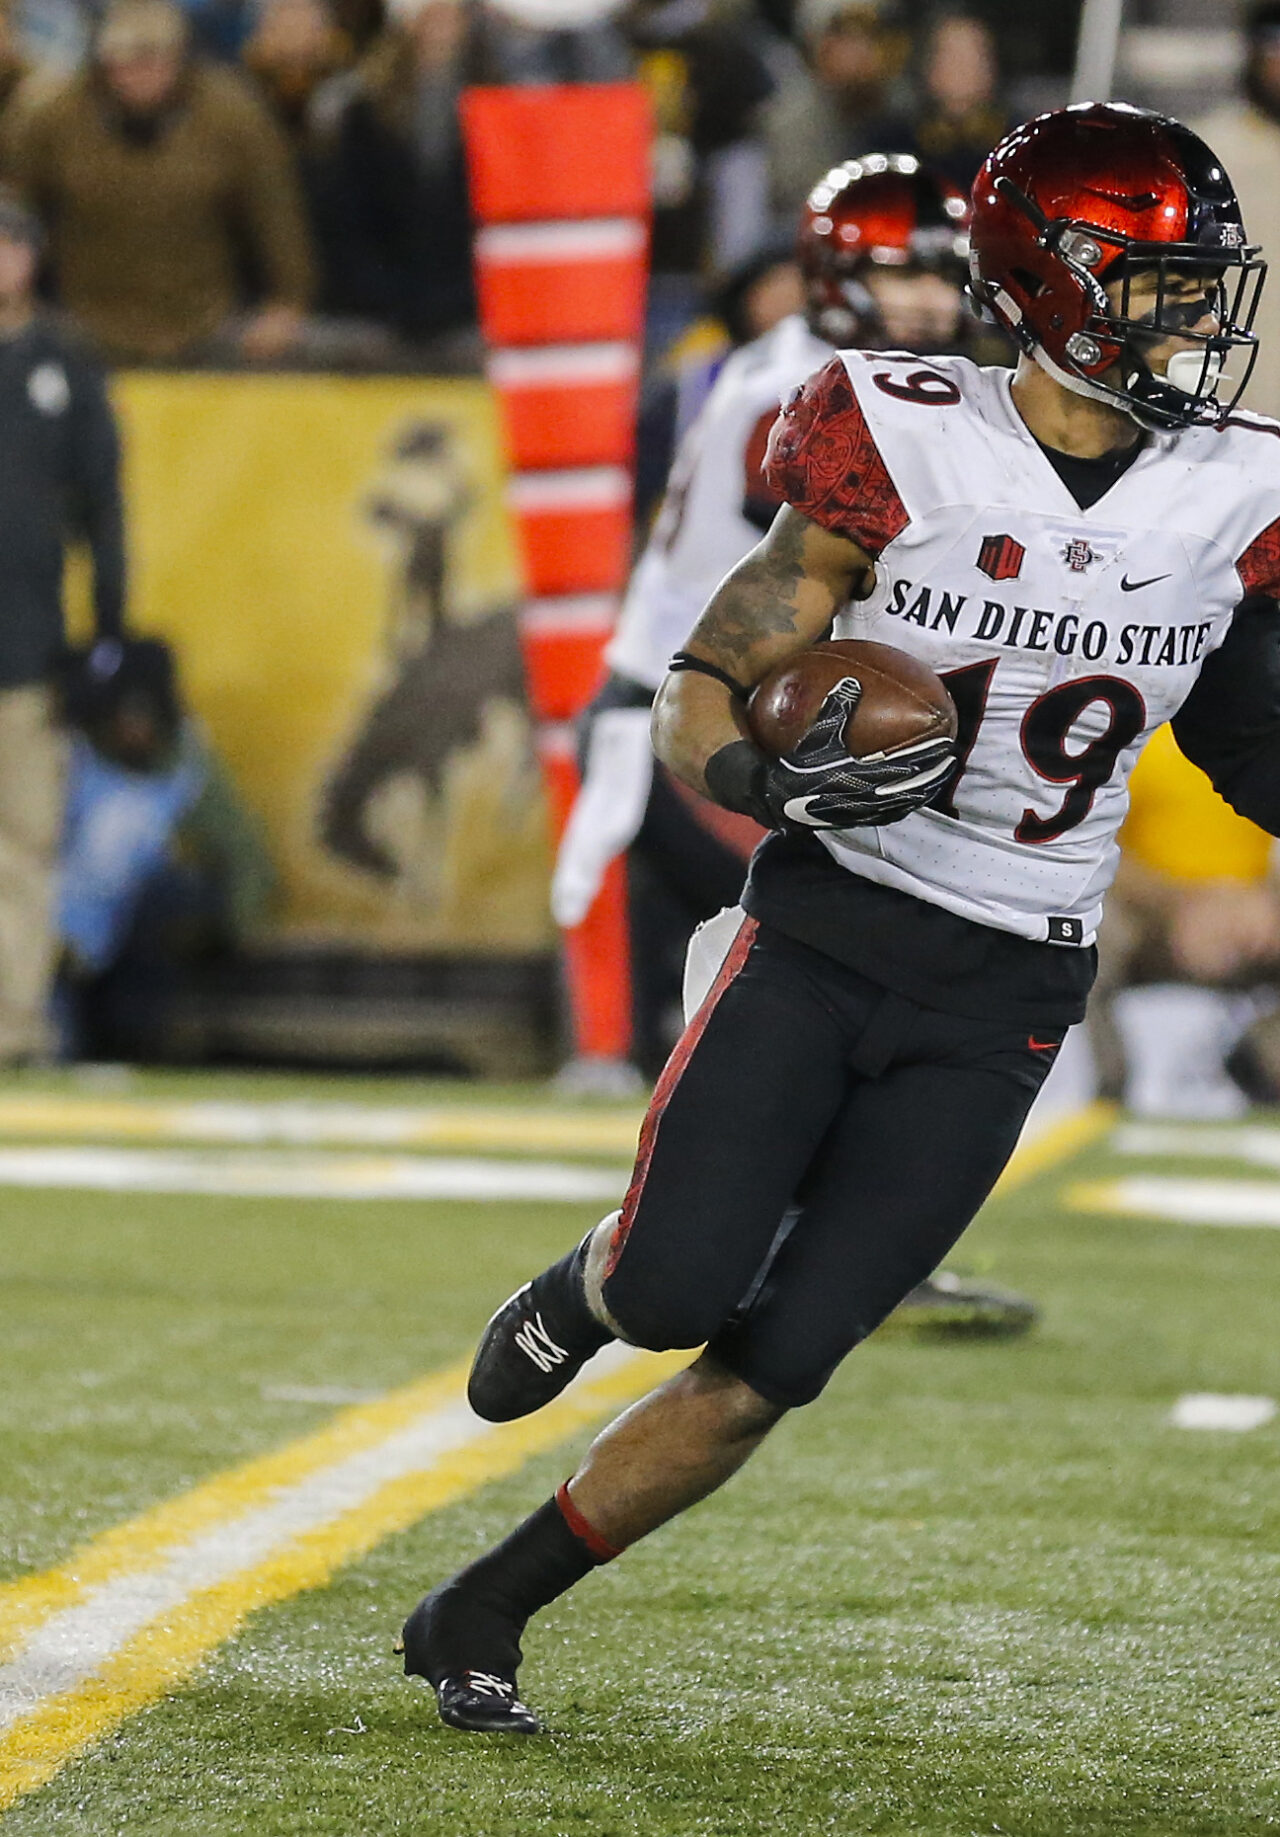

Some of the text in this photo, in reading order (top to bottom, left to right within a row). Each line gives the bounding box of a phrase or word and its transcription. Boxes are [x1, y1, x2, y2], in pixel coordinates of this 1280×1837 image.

[886, 579, 1211, 666] SAN DIEGO STATE
[926, 656, 1146, 843] 19
[1061, 922, 1074, 937] S
